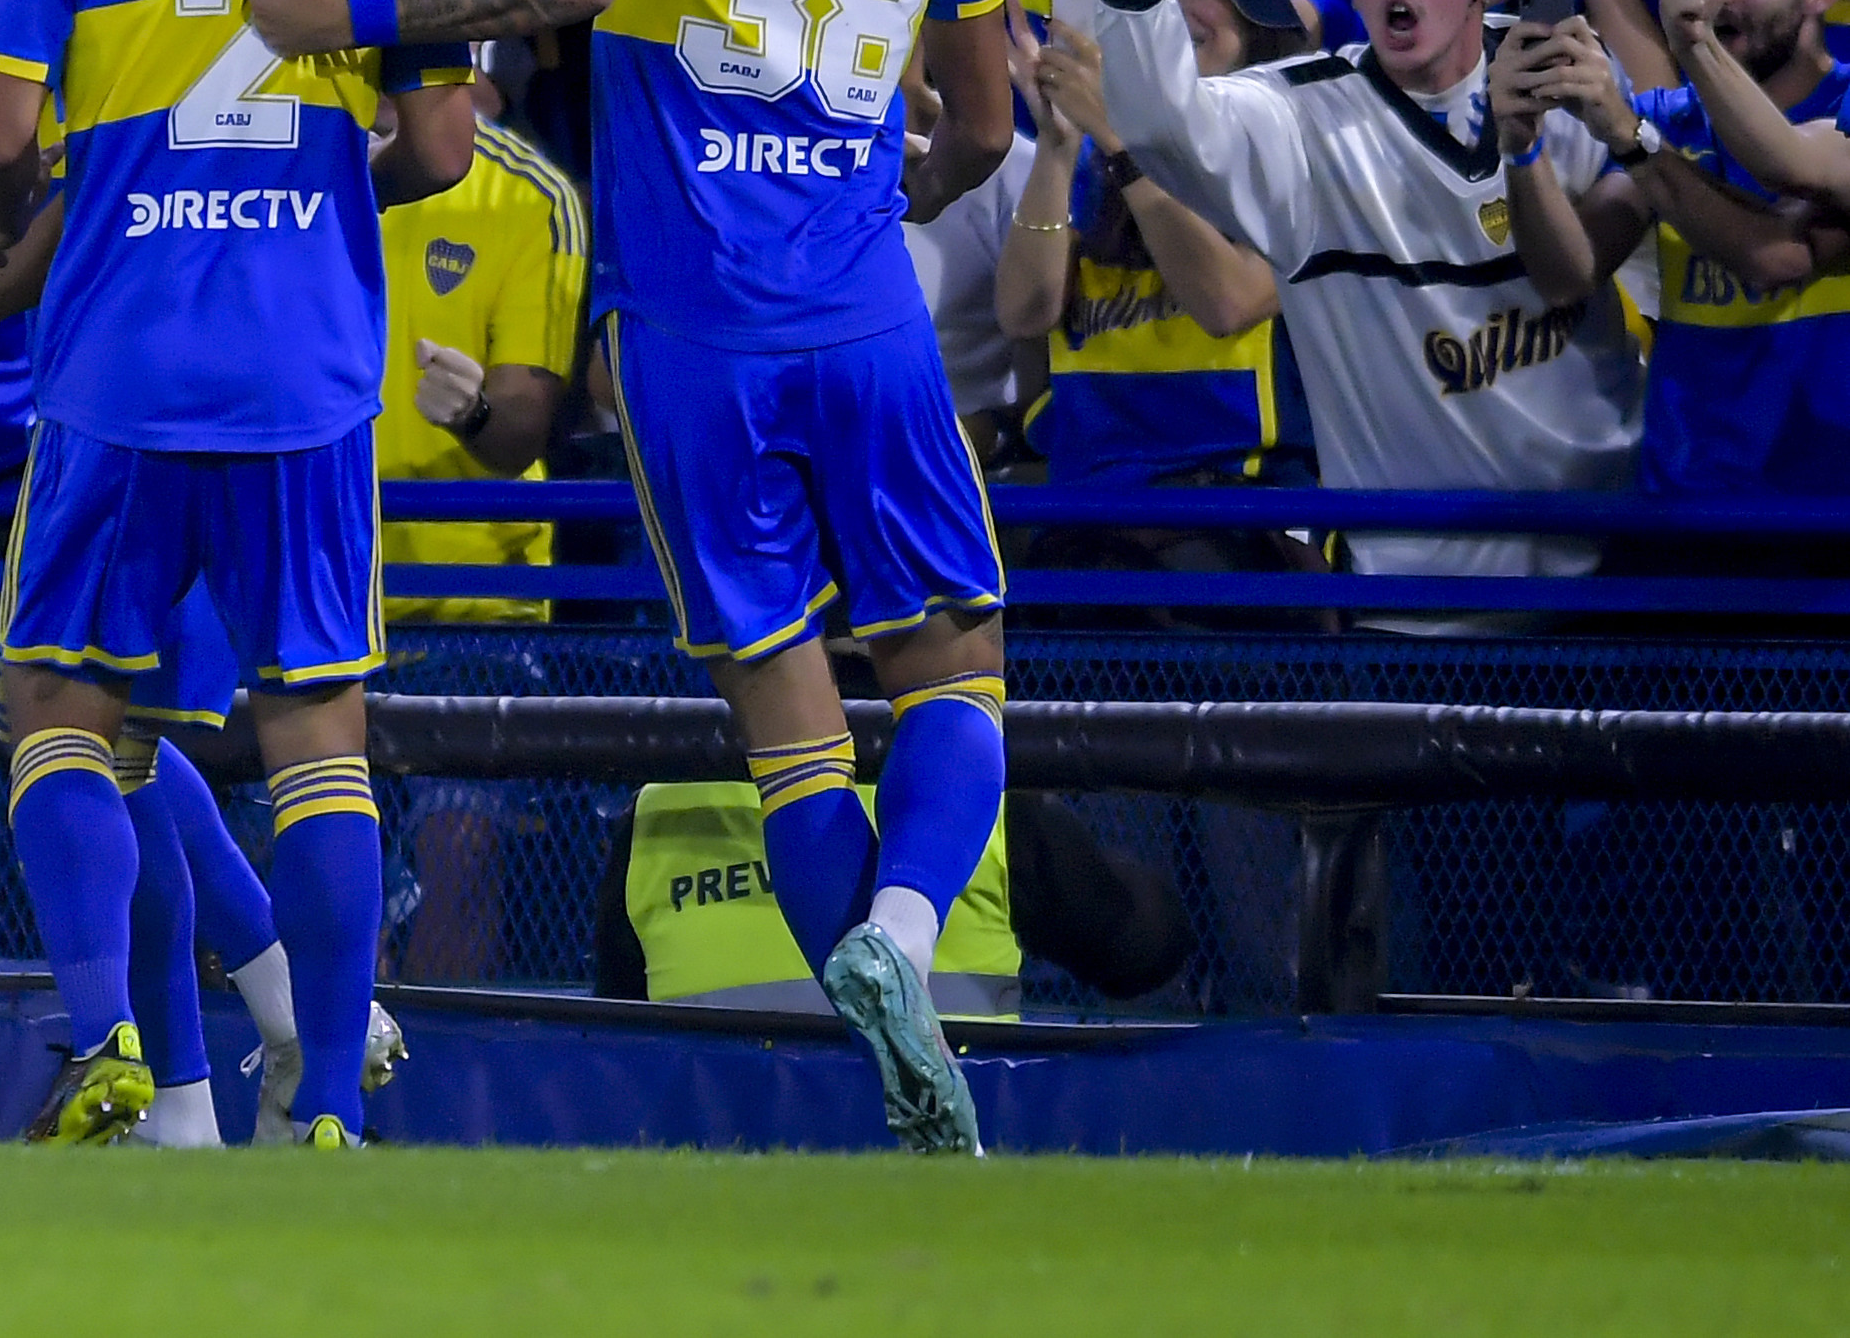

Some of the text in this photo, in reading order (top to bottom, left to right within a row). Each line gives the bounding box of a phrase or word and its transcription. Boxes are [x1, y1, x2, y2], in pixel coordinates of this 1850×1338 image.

[720, 63, 761, 80] CABJ
[847, 87, 878, 103] CABJ
[215, 113, 251, 127] CABJ
[697, 128, 876, 178] DIRECT
[125, 189, 324, 238] DIRECTV
[671, 860, 773, 912] PREV
